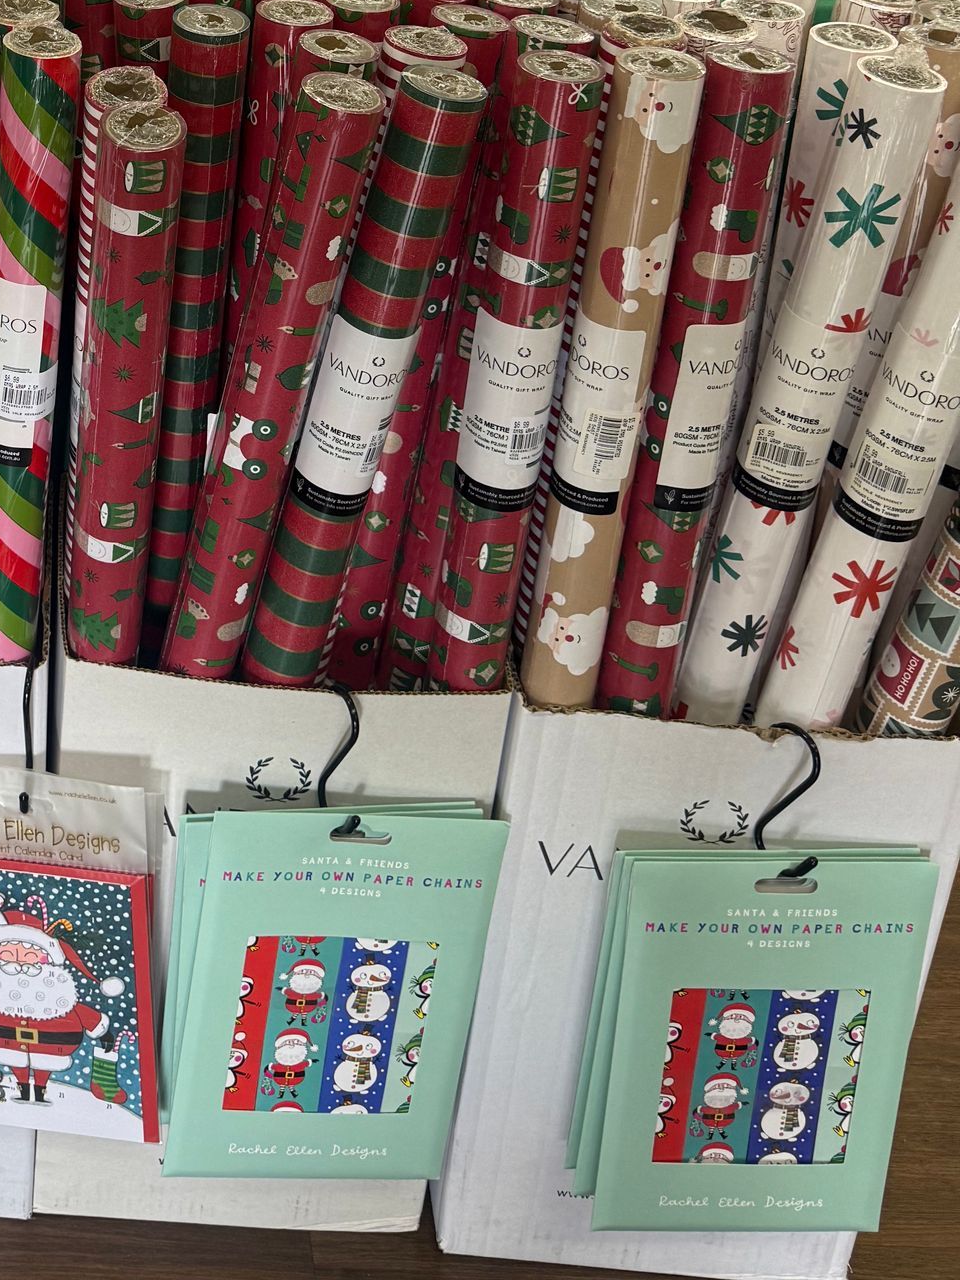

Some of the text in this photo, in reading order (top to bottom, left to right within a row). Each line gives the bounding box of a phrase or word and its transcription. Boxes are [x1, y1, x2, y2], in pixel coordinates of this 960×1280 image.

[477, 344, 559, 379] VANDORO
[330, 352, 407, 388] VANDORO
[340, 386, 364, 399] QUALITY
[488, 379, 513, 391] QUALITY
[586, 384, 603, 392] WRAP
[778, 375, 801, 390] QUALITY
[803, 387, 818, 395] GIFT
[883, 361, 960, 410] VANDORO
[774, 407, 820, 425] 2.5 METRES
[886, 396, 925, 420] QUALITY GIFT
[331, 425, 361, 442] METRES
[674, 432, 698, 441] 80GSM
[787, 423, 809, 434] 76CM
[891, 436, 925, 453] METRES
[890, 446, 913, 460] 76CM
[582, 494, 608, 502] Produced
[894, 656, 919, 699] HO HO HO!
[4, 819, 45, 843] Ellen
[51, 825, 120, 855] Designs
[14, 845, 54, 858] Calendar
[59, 850, 83, 862] Card
[301, 856, 339, 865] SANTA
[360, 858, 410, 869] FRIENDS
[222, 871, 483, 889] MAKE YOUR OWN PAPER CHAINS
[319, 887, 381, 898] 4 DESIGNS
[726, 908, 766, 918] SANTA
[787, 908, 839, 918] FRIENDS
[645, 922, 914, 935] MAKE YOUR OWN PAPER CHAINS
[747, 939, 811, 949] 4 DESIGNS
[228, 1143, 388, 1160] Rachel Ellen Designs
[659, 1195, 824, 1211] Rachel Ellen Designs
